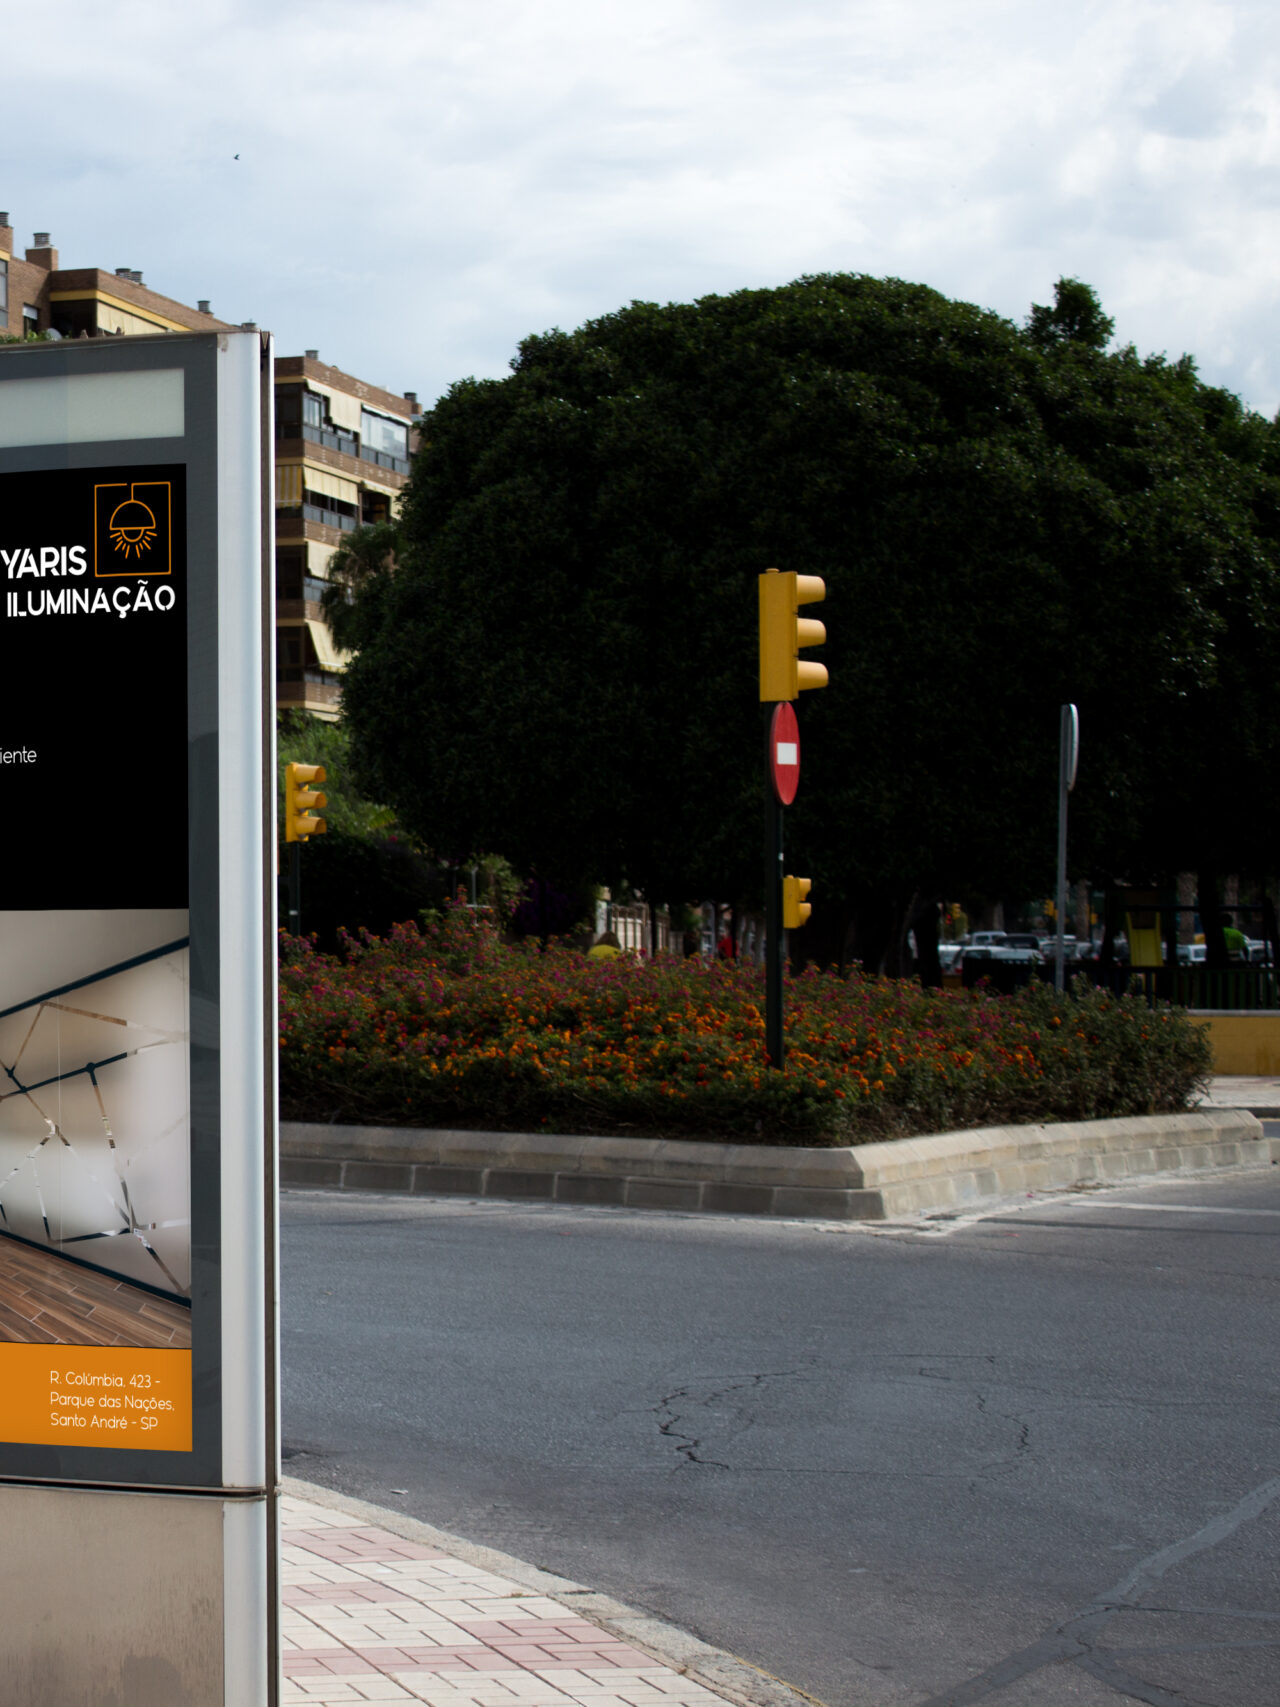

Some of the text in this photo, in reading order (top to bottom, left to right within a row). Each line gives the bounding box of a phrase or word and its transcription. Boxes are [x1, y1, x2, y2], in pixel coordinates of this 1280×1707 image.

[0, 546, 87, 579] YARIS
[7, 580, 175, 618] ILUMINAÇÃO
[50, 1370, 62, 1384] R.
[129, 1374, 152, 1389] 423
[50, 1391, 95, 1409] Parque
[98, 1394, 122, 1409] das
[50, 1412, 87, 1428] Santo
[90, 1415, 128, 1430] André
[140, 1416, 159, 1430] SP
